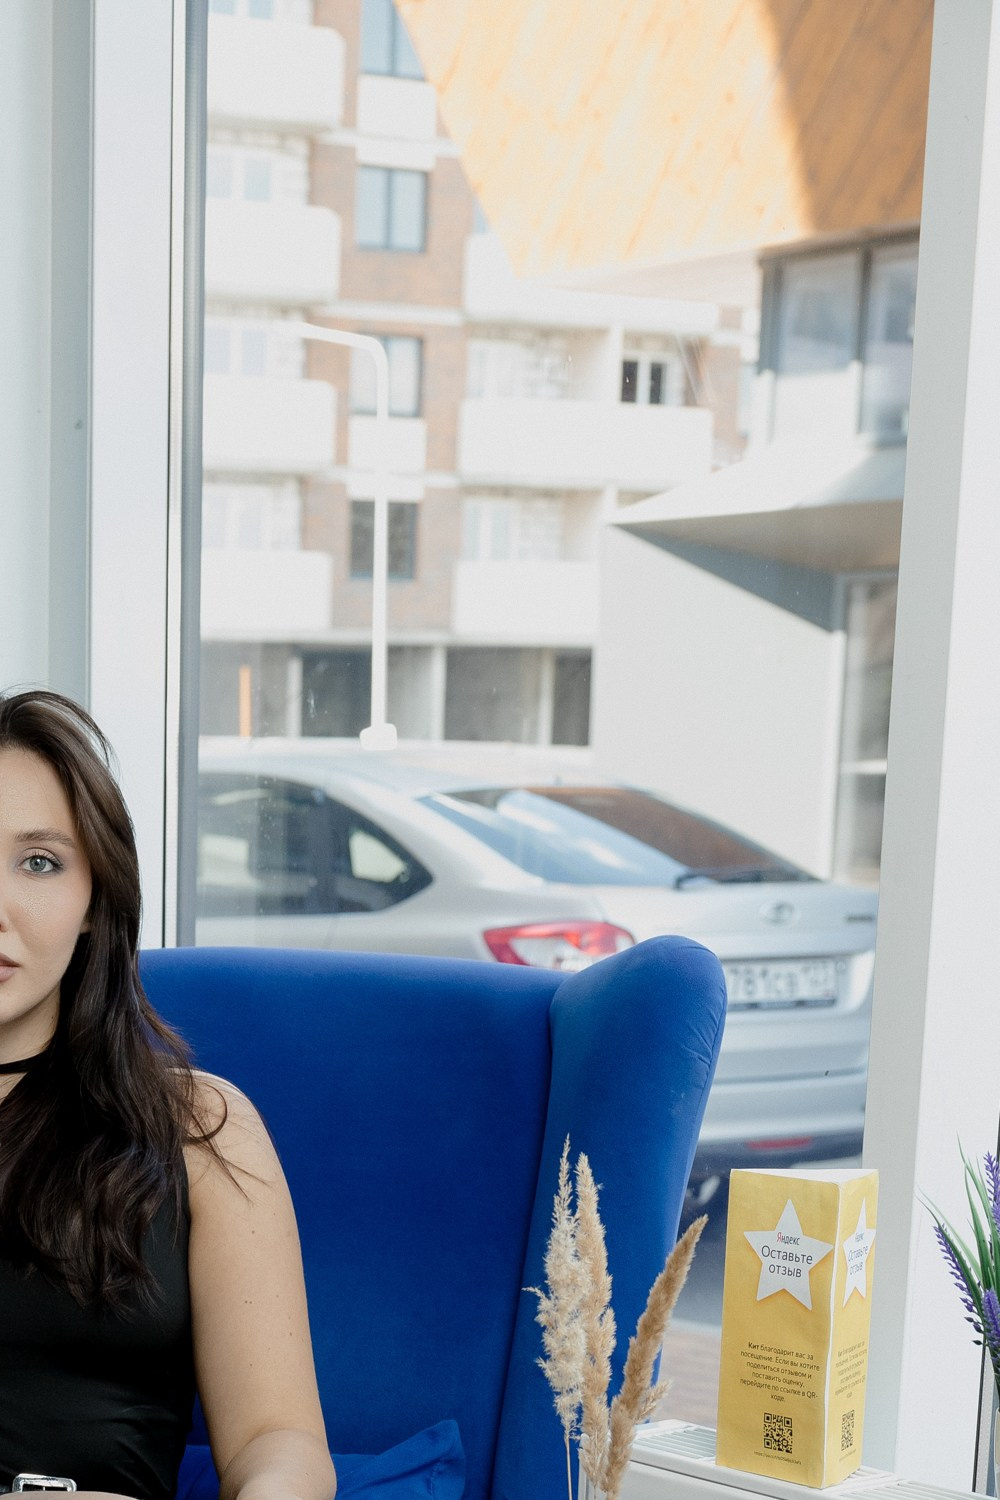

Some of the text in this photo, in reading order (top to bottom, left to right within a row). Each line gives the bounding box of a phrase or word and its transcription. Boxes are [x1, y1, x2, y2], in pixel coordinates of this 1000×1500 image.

[776, 1231, 801, 1246] Яндекс
[761, 1245, 813, 1265] Оставьте
[768, 1264, 802, 1278] отзыв
[748, 1341, 760, 1350] Кит
[760, 1344, 795, 1357] благодарит
[795, 1352, 806, 1360] вас
[746, 1361, 780, 1373] поделиться
[780, 1368, 807, 1378] отзывом
[775, 1356, 790, 1365] Если
[799, 1362, 820, 1371] хотите
[751, 1371, 782, 1383] поставить
[740, 1378, 771, 1390] перейдите
[779, 1386, 801, 1396] ссылке
